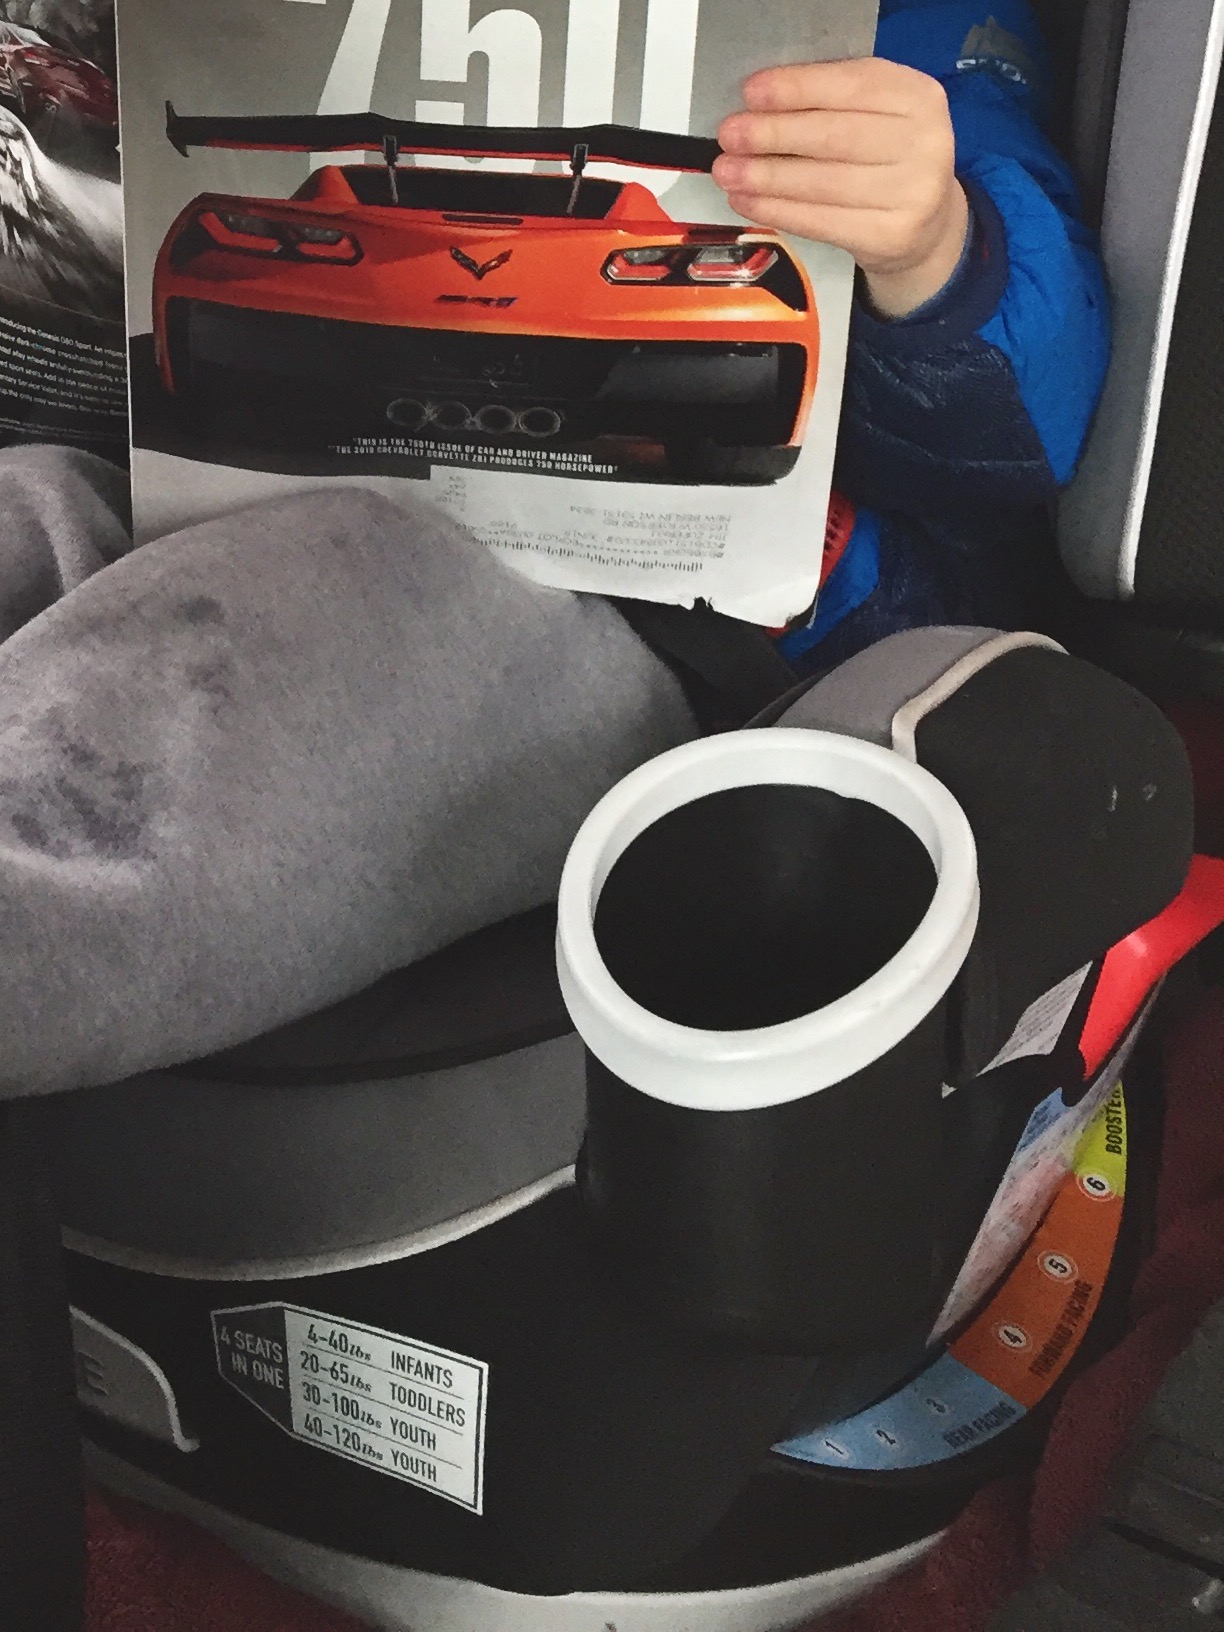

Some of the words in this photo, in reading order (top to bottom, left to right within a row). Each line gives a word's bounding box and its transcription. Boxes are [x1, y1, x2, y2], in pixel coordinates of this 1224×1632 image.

[516, 449, 548, 461] DRIVER
[549, 451, 593, 464] MAGAZINE
[1047, 1257, 1069, 1275] 5
[234, 1330, 284, 1365] SEATS
[1003, 1328, 1024, 1345] 4
[232, 1351, 250, 1377] IN
[252, 1360, 285, 1391] ONE
[390, 1350, 454, 1389] INFANTS
[387, 1381, 466, 1428] TODDLERS
[389, 1416, 437, 1452] YOUTH
[390, 1448, 438, 1483] YOUTH
